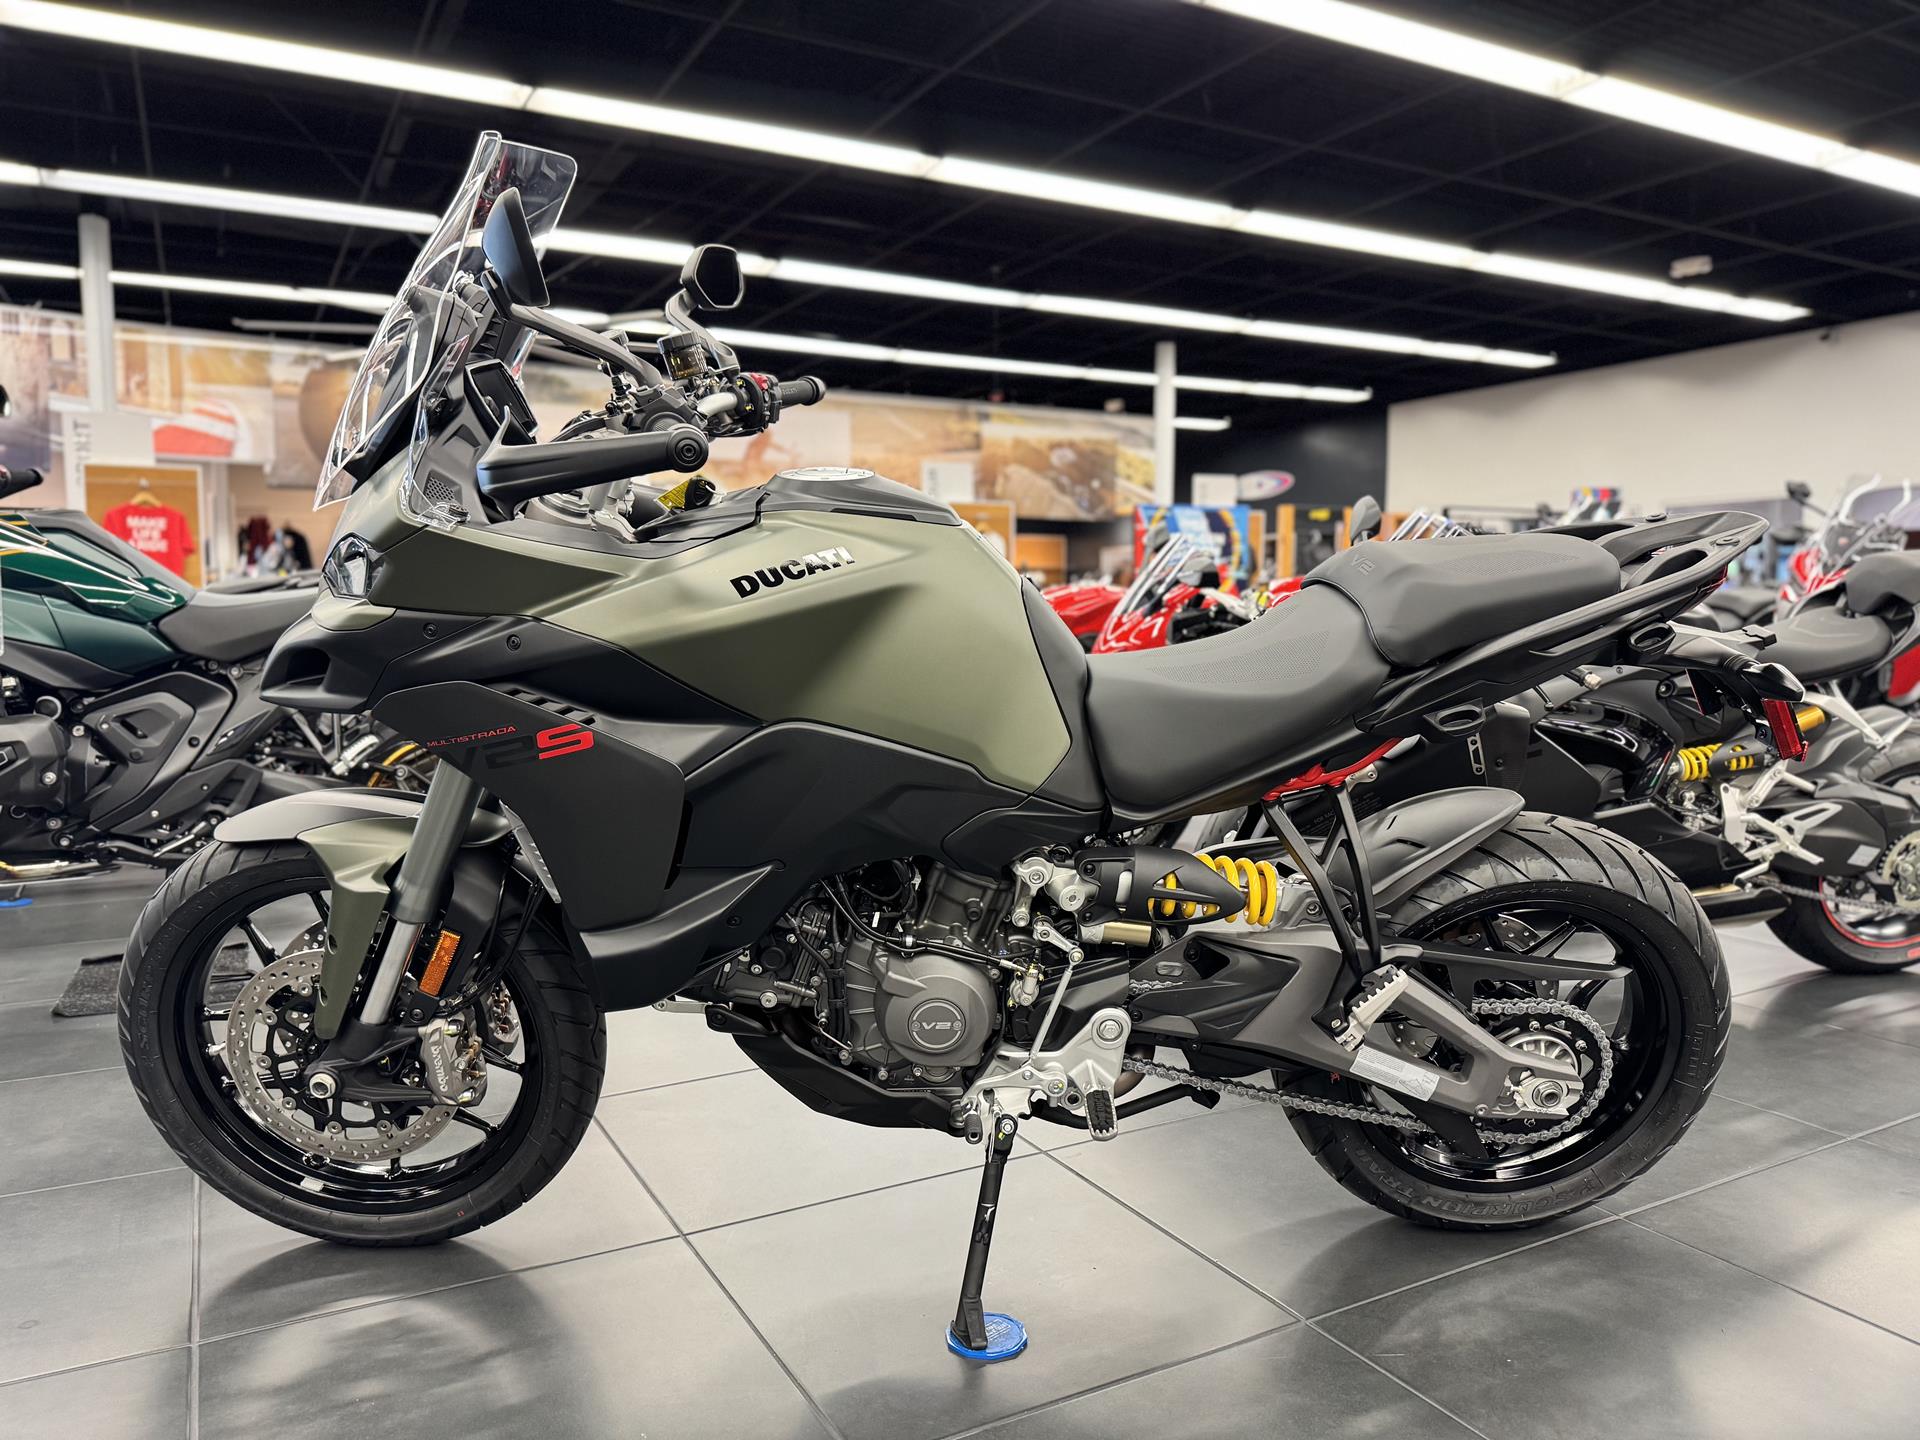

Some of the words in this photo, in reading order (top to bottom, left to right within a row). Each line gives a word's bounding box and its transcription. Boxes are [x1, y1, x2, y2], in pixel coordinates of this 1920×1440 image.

[126, 515, 168, 530] MAKE
[730, 546, 855, 598] DUCATI
[1352, 554, 1376, 576] V2
[427, 725, 517, 748] MULTISTRADA
[922, 1022, 952, 1030] V2
[430, 1045, 449, 1092] brembo
